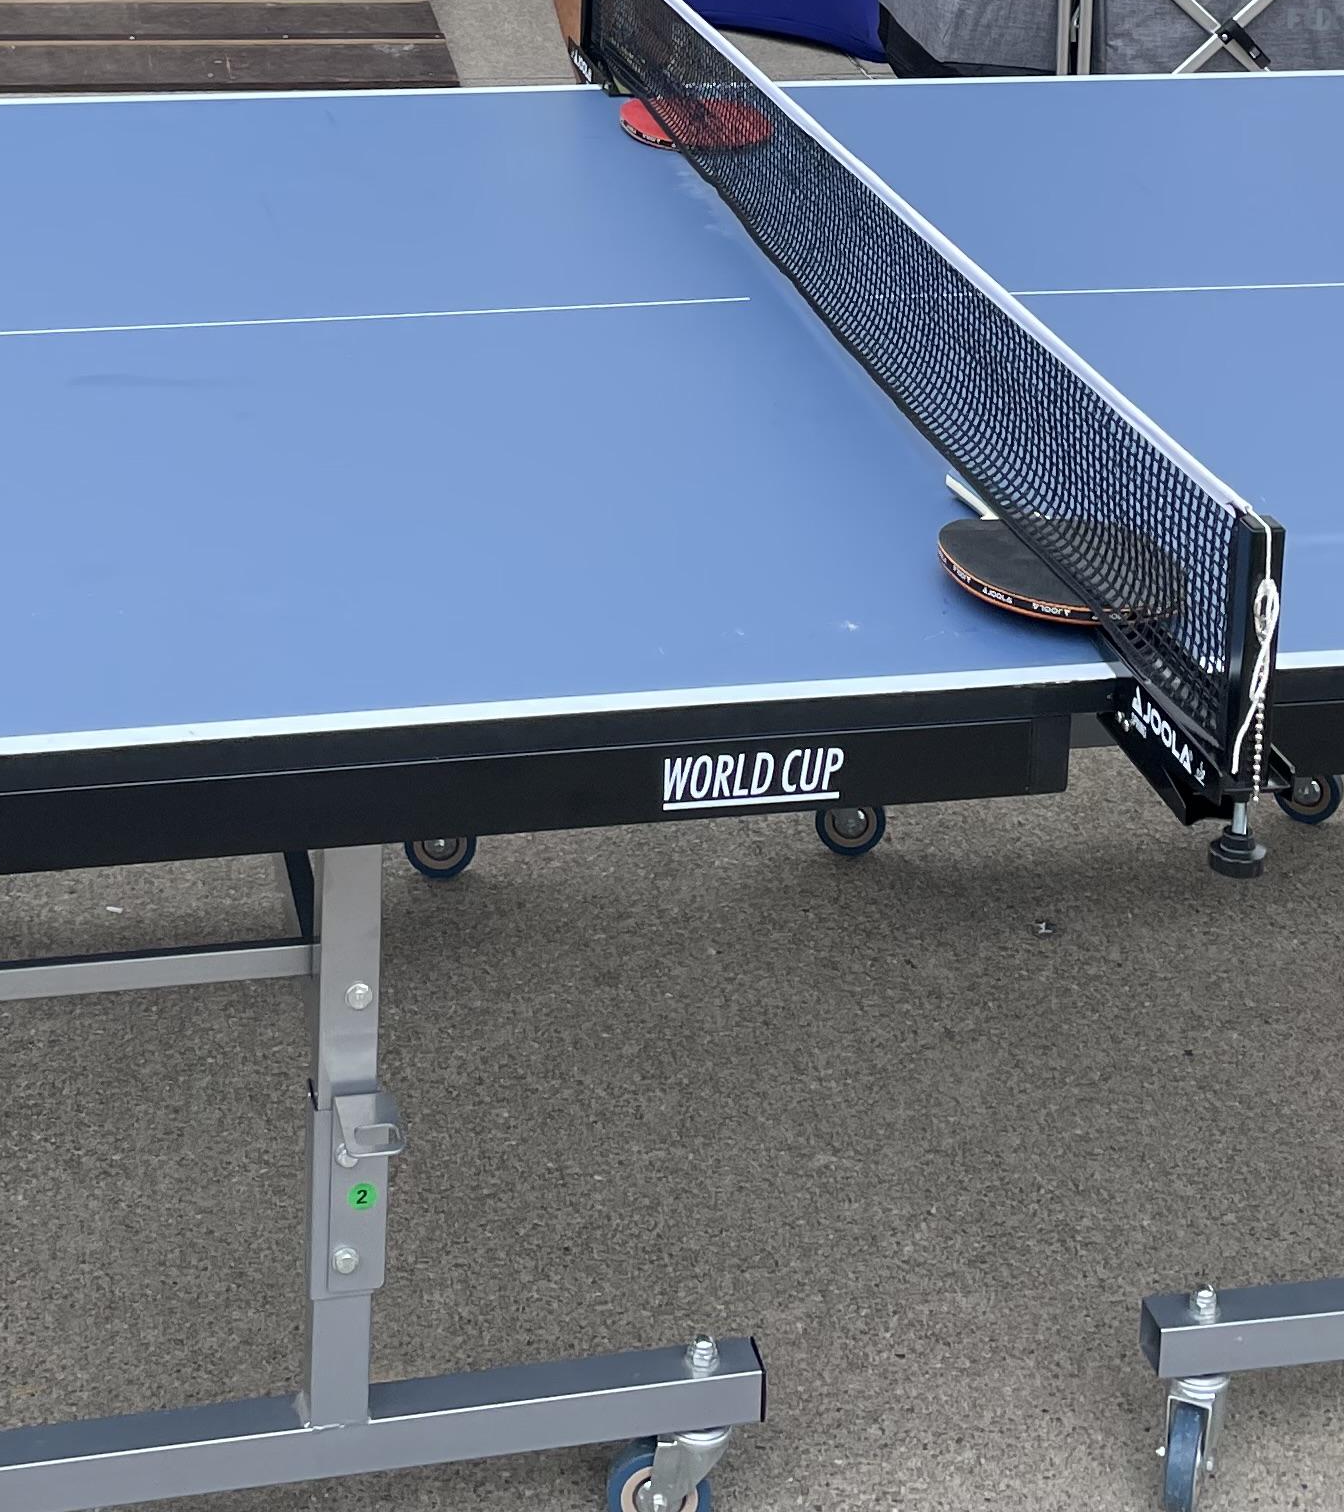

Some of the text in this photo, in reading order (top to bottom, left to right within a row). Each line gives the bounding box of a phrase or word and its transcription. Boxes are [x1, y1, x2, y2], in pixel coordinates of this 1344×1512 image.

[1142, 701, 1193, 775] JOOLA
[663, 747, 845, 801] WORLD CUP
[355, 1189, 368, 1205] 2
